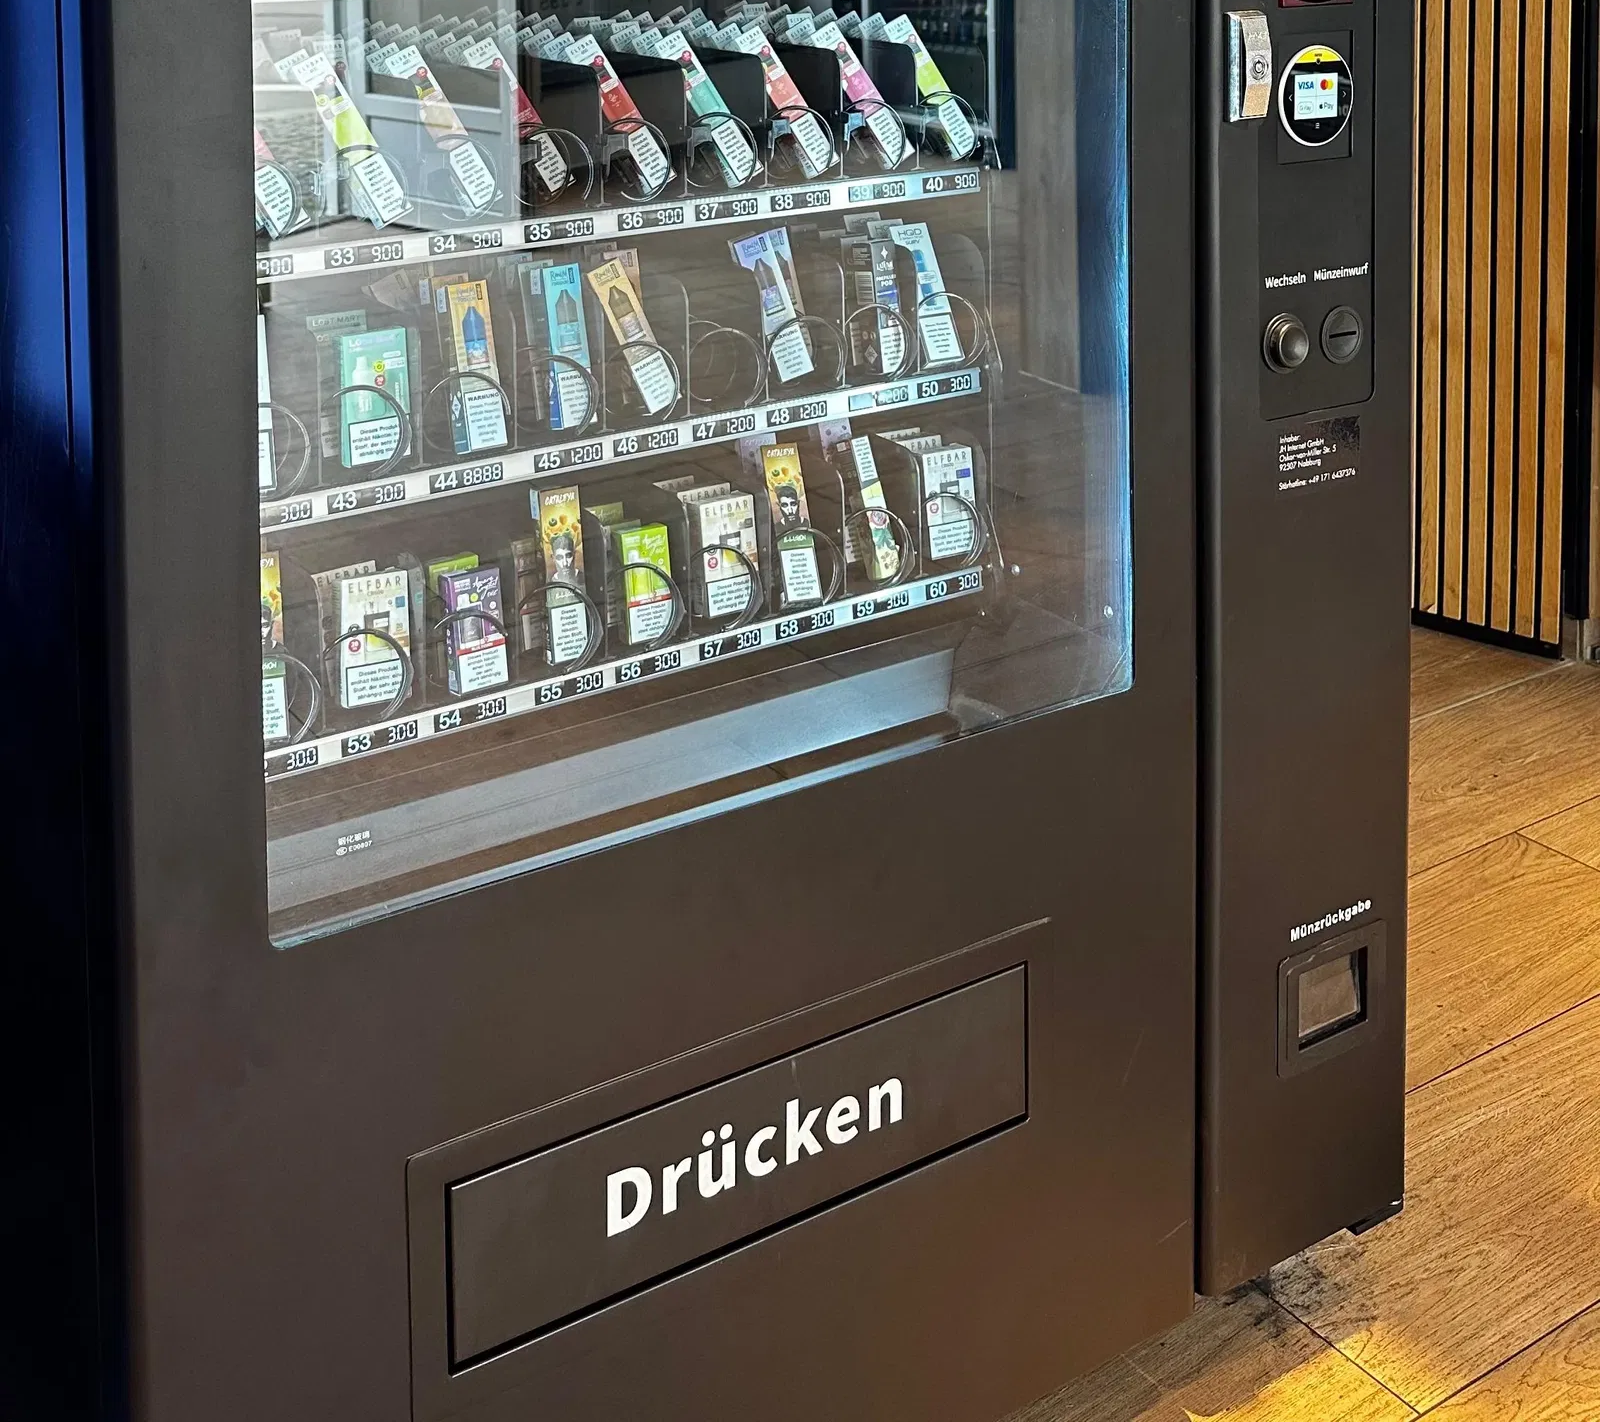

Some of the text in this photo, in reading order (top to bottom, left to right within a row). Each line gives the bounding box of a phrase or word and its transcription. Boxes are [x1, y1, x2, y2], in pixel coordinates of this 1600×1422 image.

[1298, 81, 1314, 89] VISA
[926, 178, 943, 191] 40
[853, 187, 871, 200] 39
[775, 195, 793, 210] 38
[699, 204, 718, 219] 37
[622, 213, 643, 228] 36
[530, 224, 551, 240] 35
[434, 235, 456, 253] 34
[330, 249, 354, 266] 33
[1265, 263, 1369, 289] Wechseln Münzeinwurf
[922, 381, 938, 397] 50
[771, 409, 789, 424] 48
[697, 422, 716, 438] 47
[617, 437, 638, 454] 46
[1288, 442, 1306, 451] Internet
[1307, 438, 1324, 447] GmbH
[1332, 444, 1336, 452] 5
[538, 454, 560, 470] 45
[927, 451, 967, 466] ELFBAR
[435, 473, 457, 490] 44
[1321, 473, 1330, 481] 171
[332, 491, 357, 511] 43
[682, 487, 726, 502] ELFBAR
[705, 499, 748, 517] ELFBAR
[348, 576, 401, 594] ELFBAR
[930, 581, 947, 597] 60
[857, 600, 875, 617] 59
[779, 620, 799, 637] 58
[704, 640, 723, 658] 57
[621, 662, 641, 680] 56
[540, 684, 562, 702] 55
[439, 709, 462, 729] 54
[348, 734, 372, 753] 53
[1290, 899, 1372, 942] Münzrückgabe
[607, 1077, 903, 1238] Drücken
